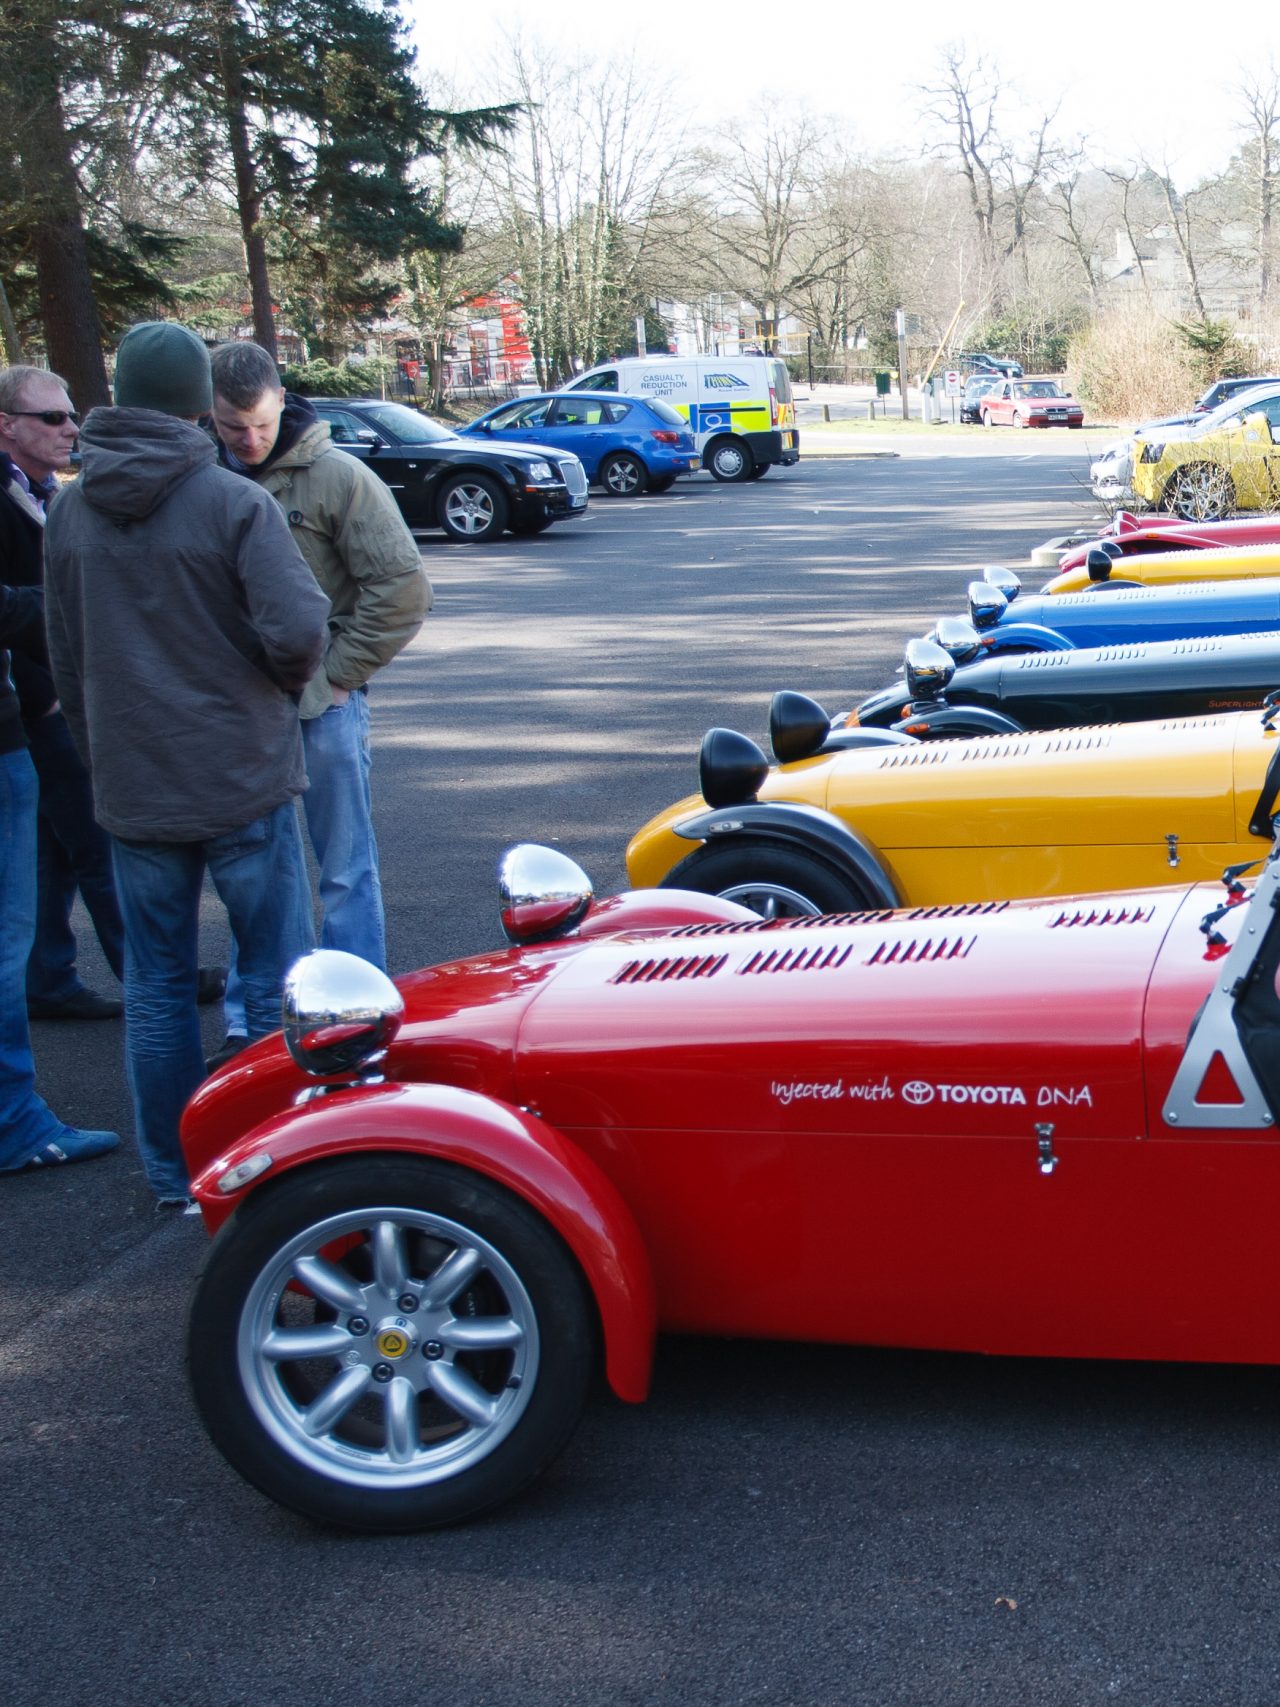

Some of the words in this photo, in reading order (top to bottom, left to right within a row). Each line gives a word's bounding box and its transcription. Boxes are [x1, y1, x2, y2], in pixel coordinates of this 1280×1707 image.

[643, 374, 684, 383] CASUALTY
[641, 381, 687, 389] REDUCTION
[771, 1075, 844, 1105] Injected
[849, 1076, 895, 1101] with
[936, 1084, 1027, 1105] TOYOTA
[1037, 1085, 1093, 1108] DNA
